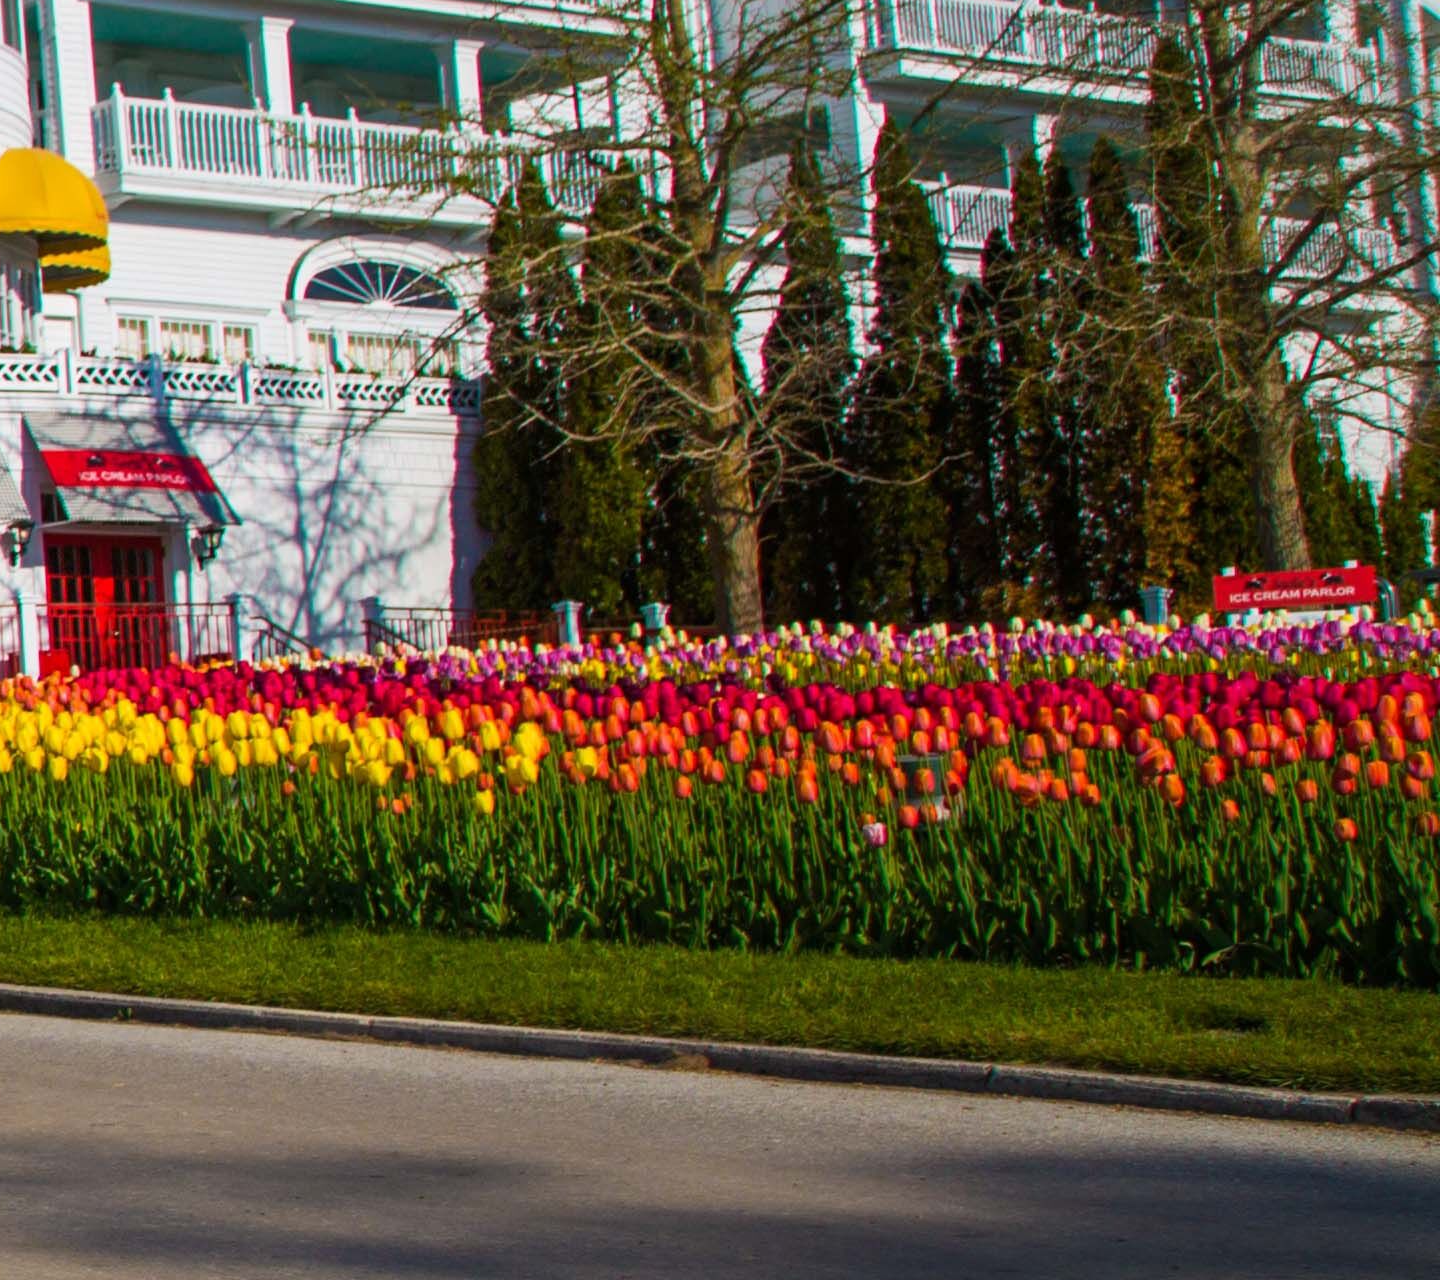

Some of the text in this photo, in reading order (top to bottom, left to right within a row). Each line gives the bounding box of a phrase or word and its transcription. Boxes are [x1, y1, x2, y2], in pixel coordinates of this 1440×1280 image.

[1229, 585, 1356, 603] ICE CREAM PARLOR
